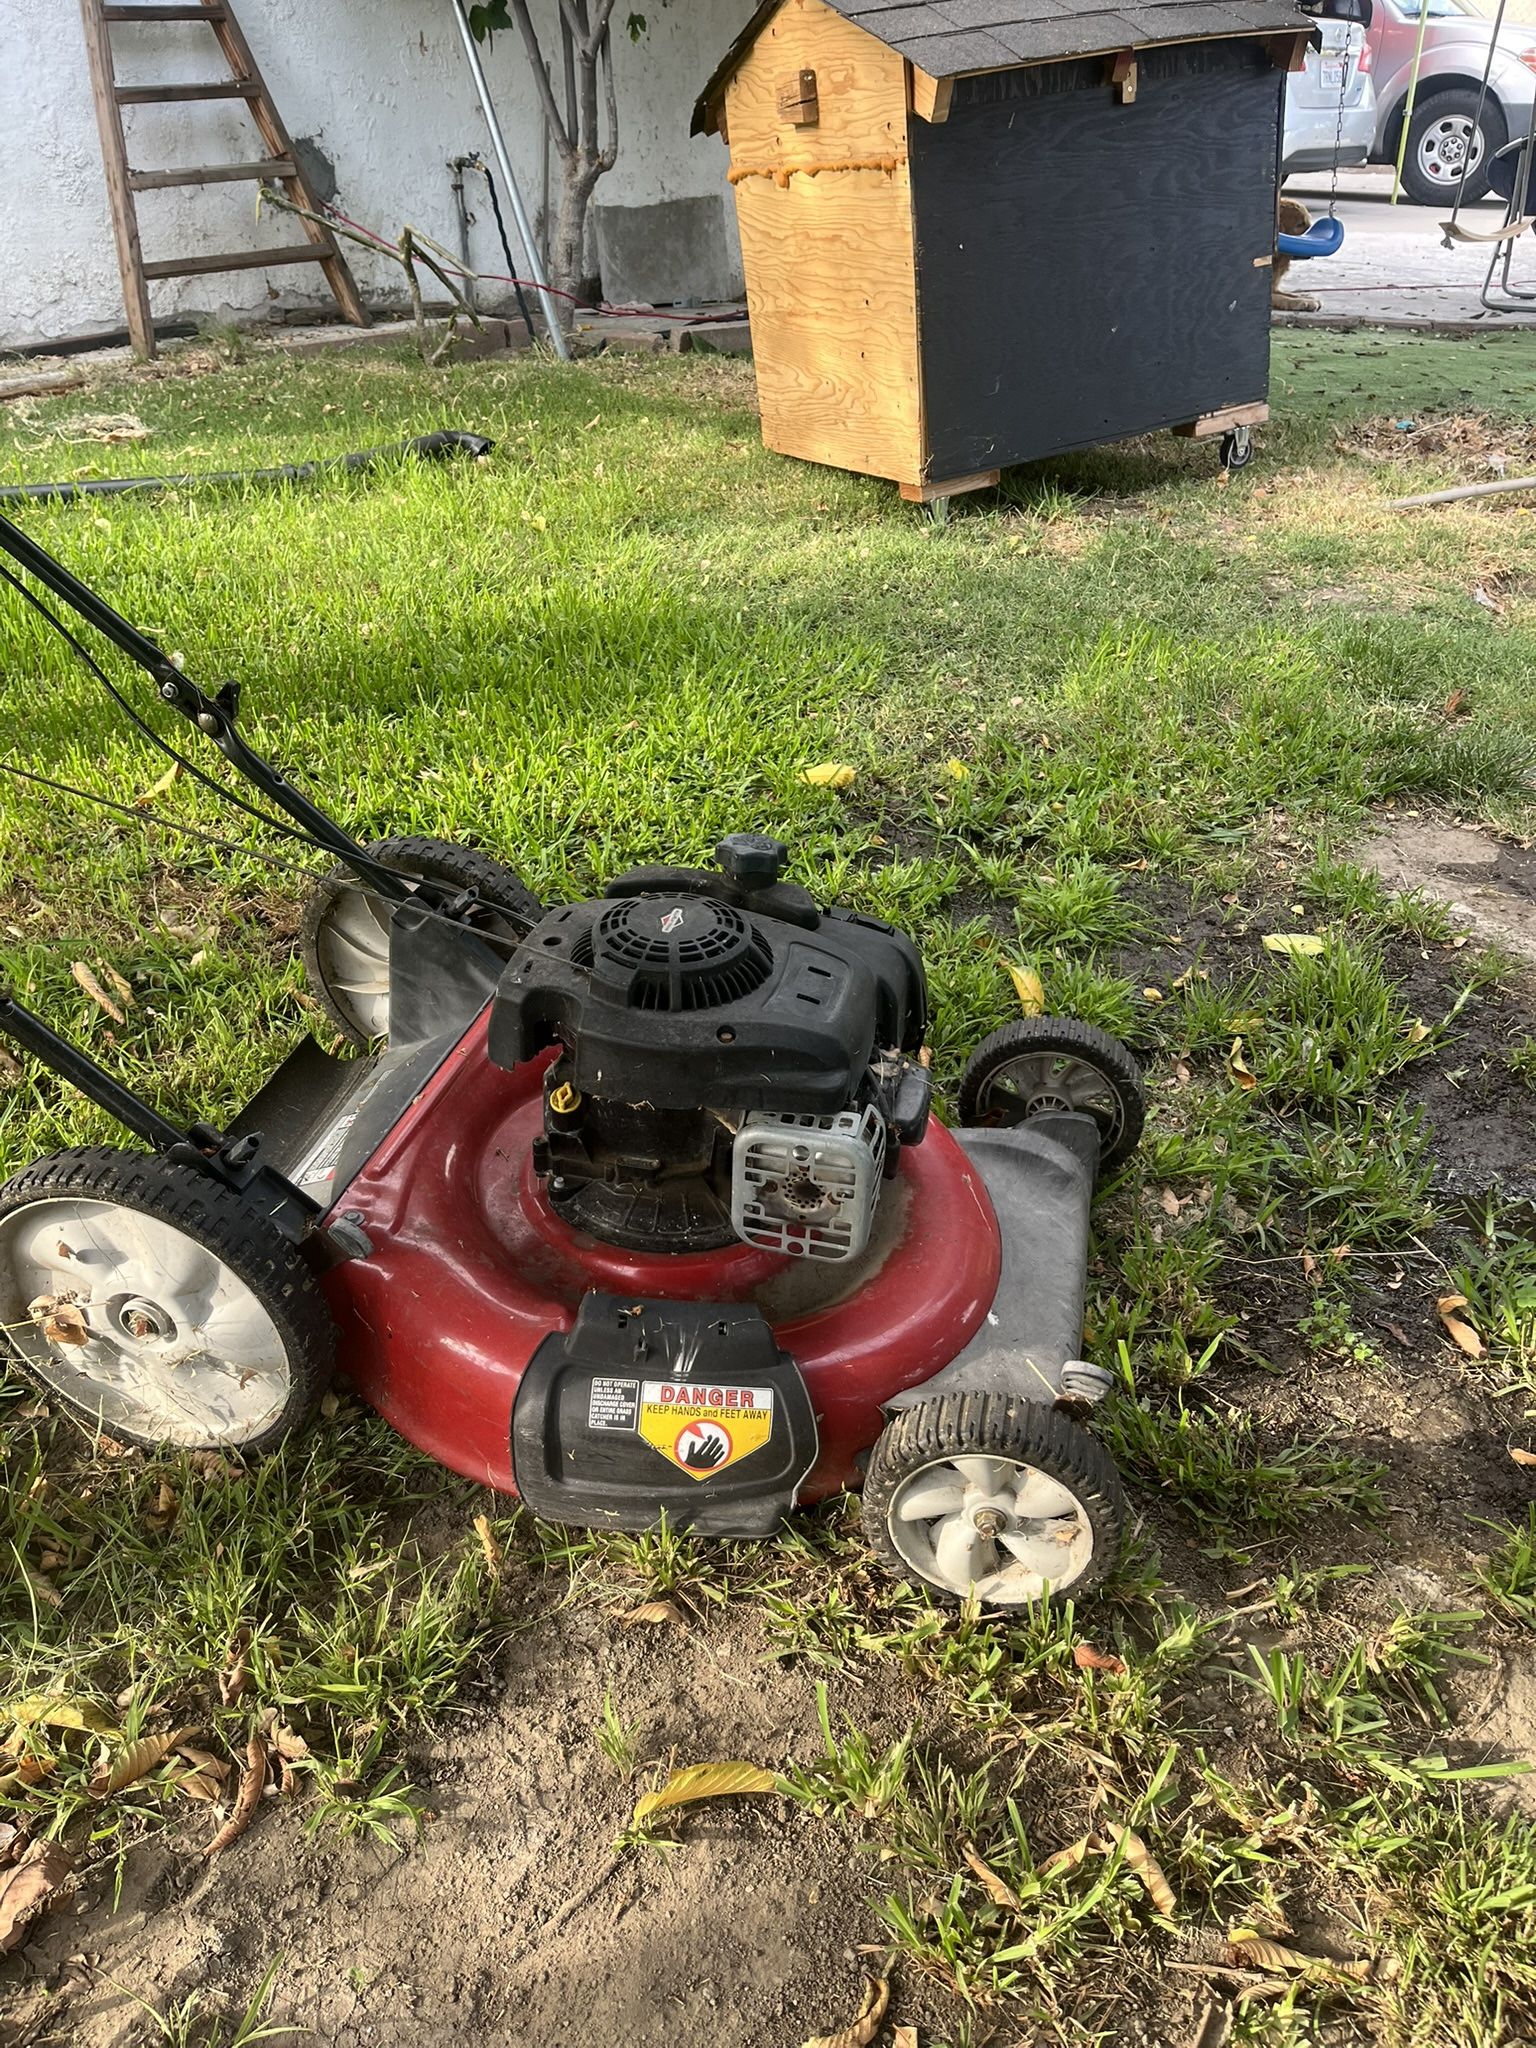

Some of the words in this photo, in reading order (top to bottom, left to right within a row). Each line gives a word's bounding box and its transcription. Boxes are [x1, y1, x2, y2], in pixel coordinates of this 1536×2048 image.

[661, 1386, 754, 1407] DANGER
[647, 1404, 670, 1414] KEEP
[672, 1407, 700, 1416] HANDS
[720, 1410, 740, 1418] FEET
[743, 1410, 768, 1420] AWAY
